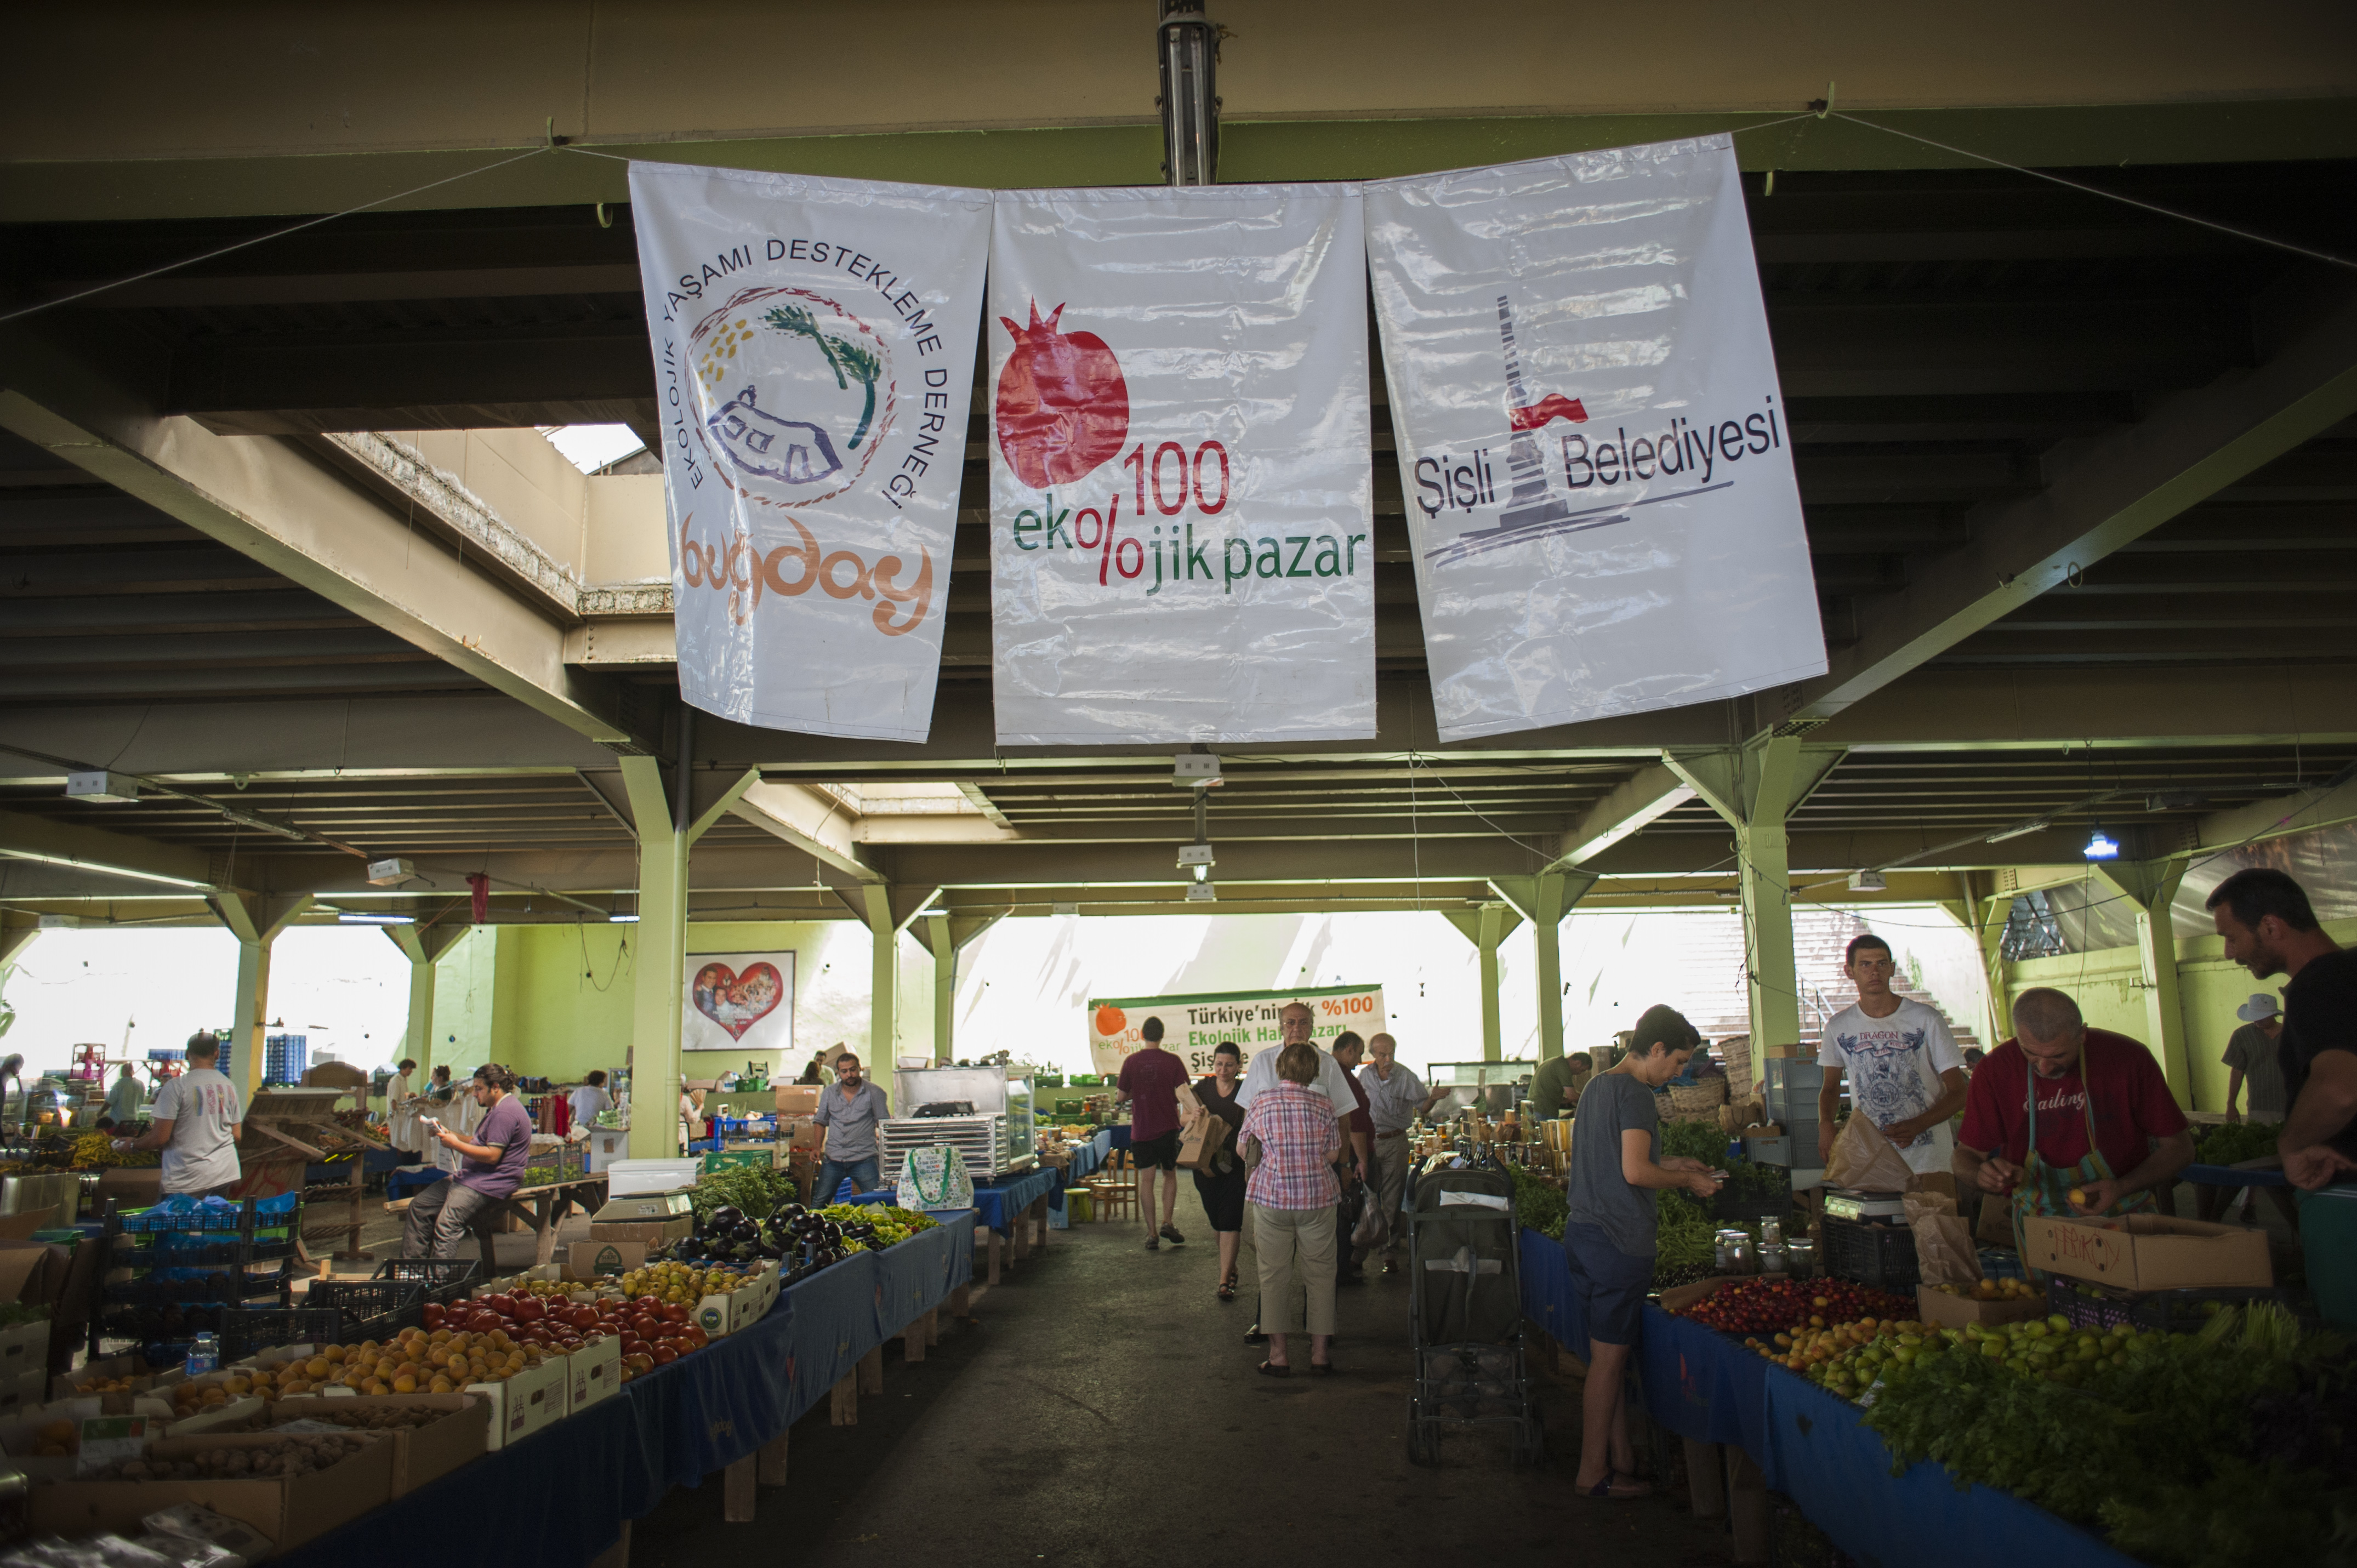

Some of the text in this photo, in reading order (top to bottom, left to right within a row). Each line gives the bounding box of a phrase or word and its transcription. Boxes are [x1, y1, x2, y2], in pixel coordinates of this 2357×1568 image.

[664, 244, 753, 323] YAŞAMI
[767, 239, 942, 356] DESTEKLEME
[881, 368, 948, 510] DERNEĞİ
[1124, 440, 1230, 516] 100
[1414, 395, 1780, 519] Şişli Belediyesi
[1224, 533, 1367, 595] pazar
[1257, 1026, 1283, 1041] Hal
[1321, 995, 1373, 1016] %100
[1859, 1031, 1898, 1040] DRAGON
